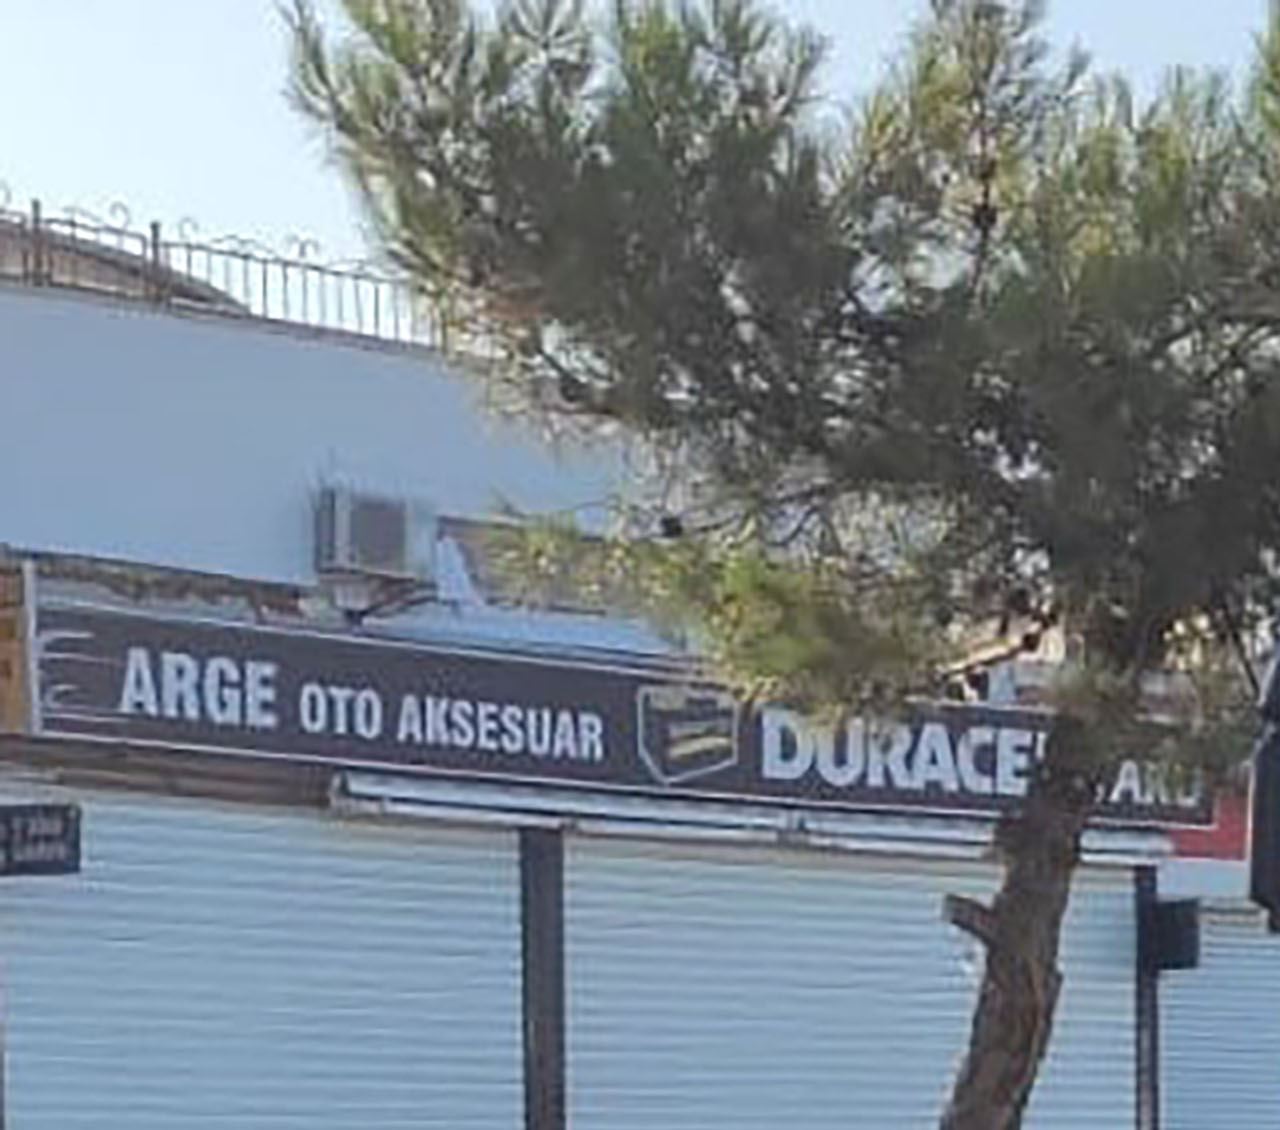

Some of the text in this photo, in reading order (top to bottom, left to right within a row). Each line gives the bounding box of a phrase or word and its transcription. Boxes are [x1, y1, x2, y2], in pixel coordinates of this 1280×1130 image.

[118, 646, 605, 762] ARGE OTO AKSESUAR
